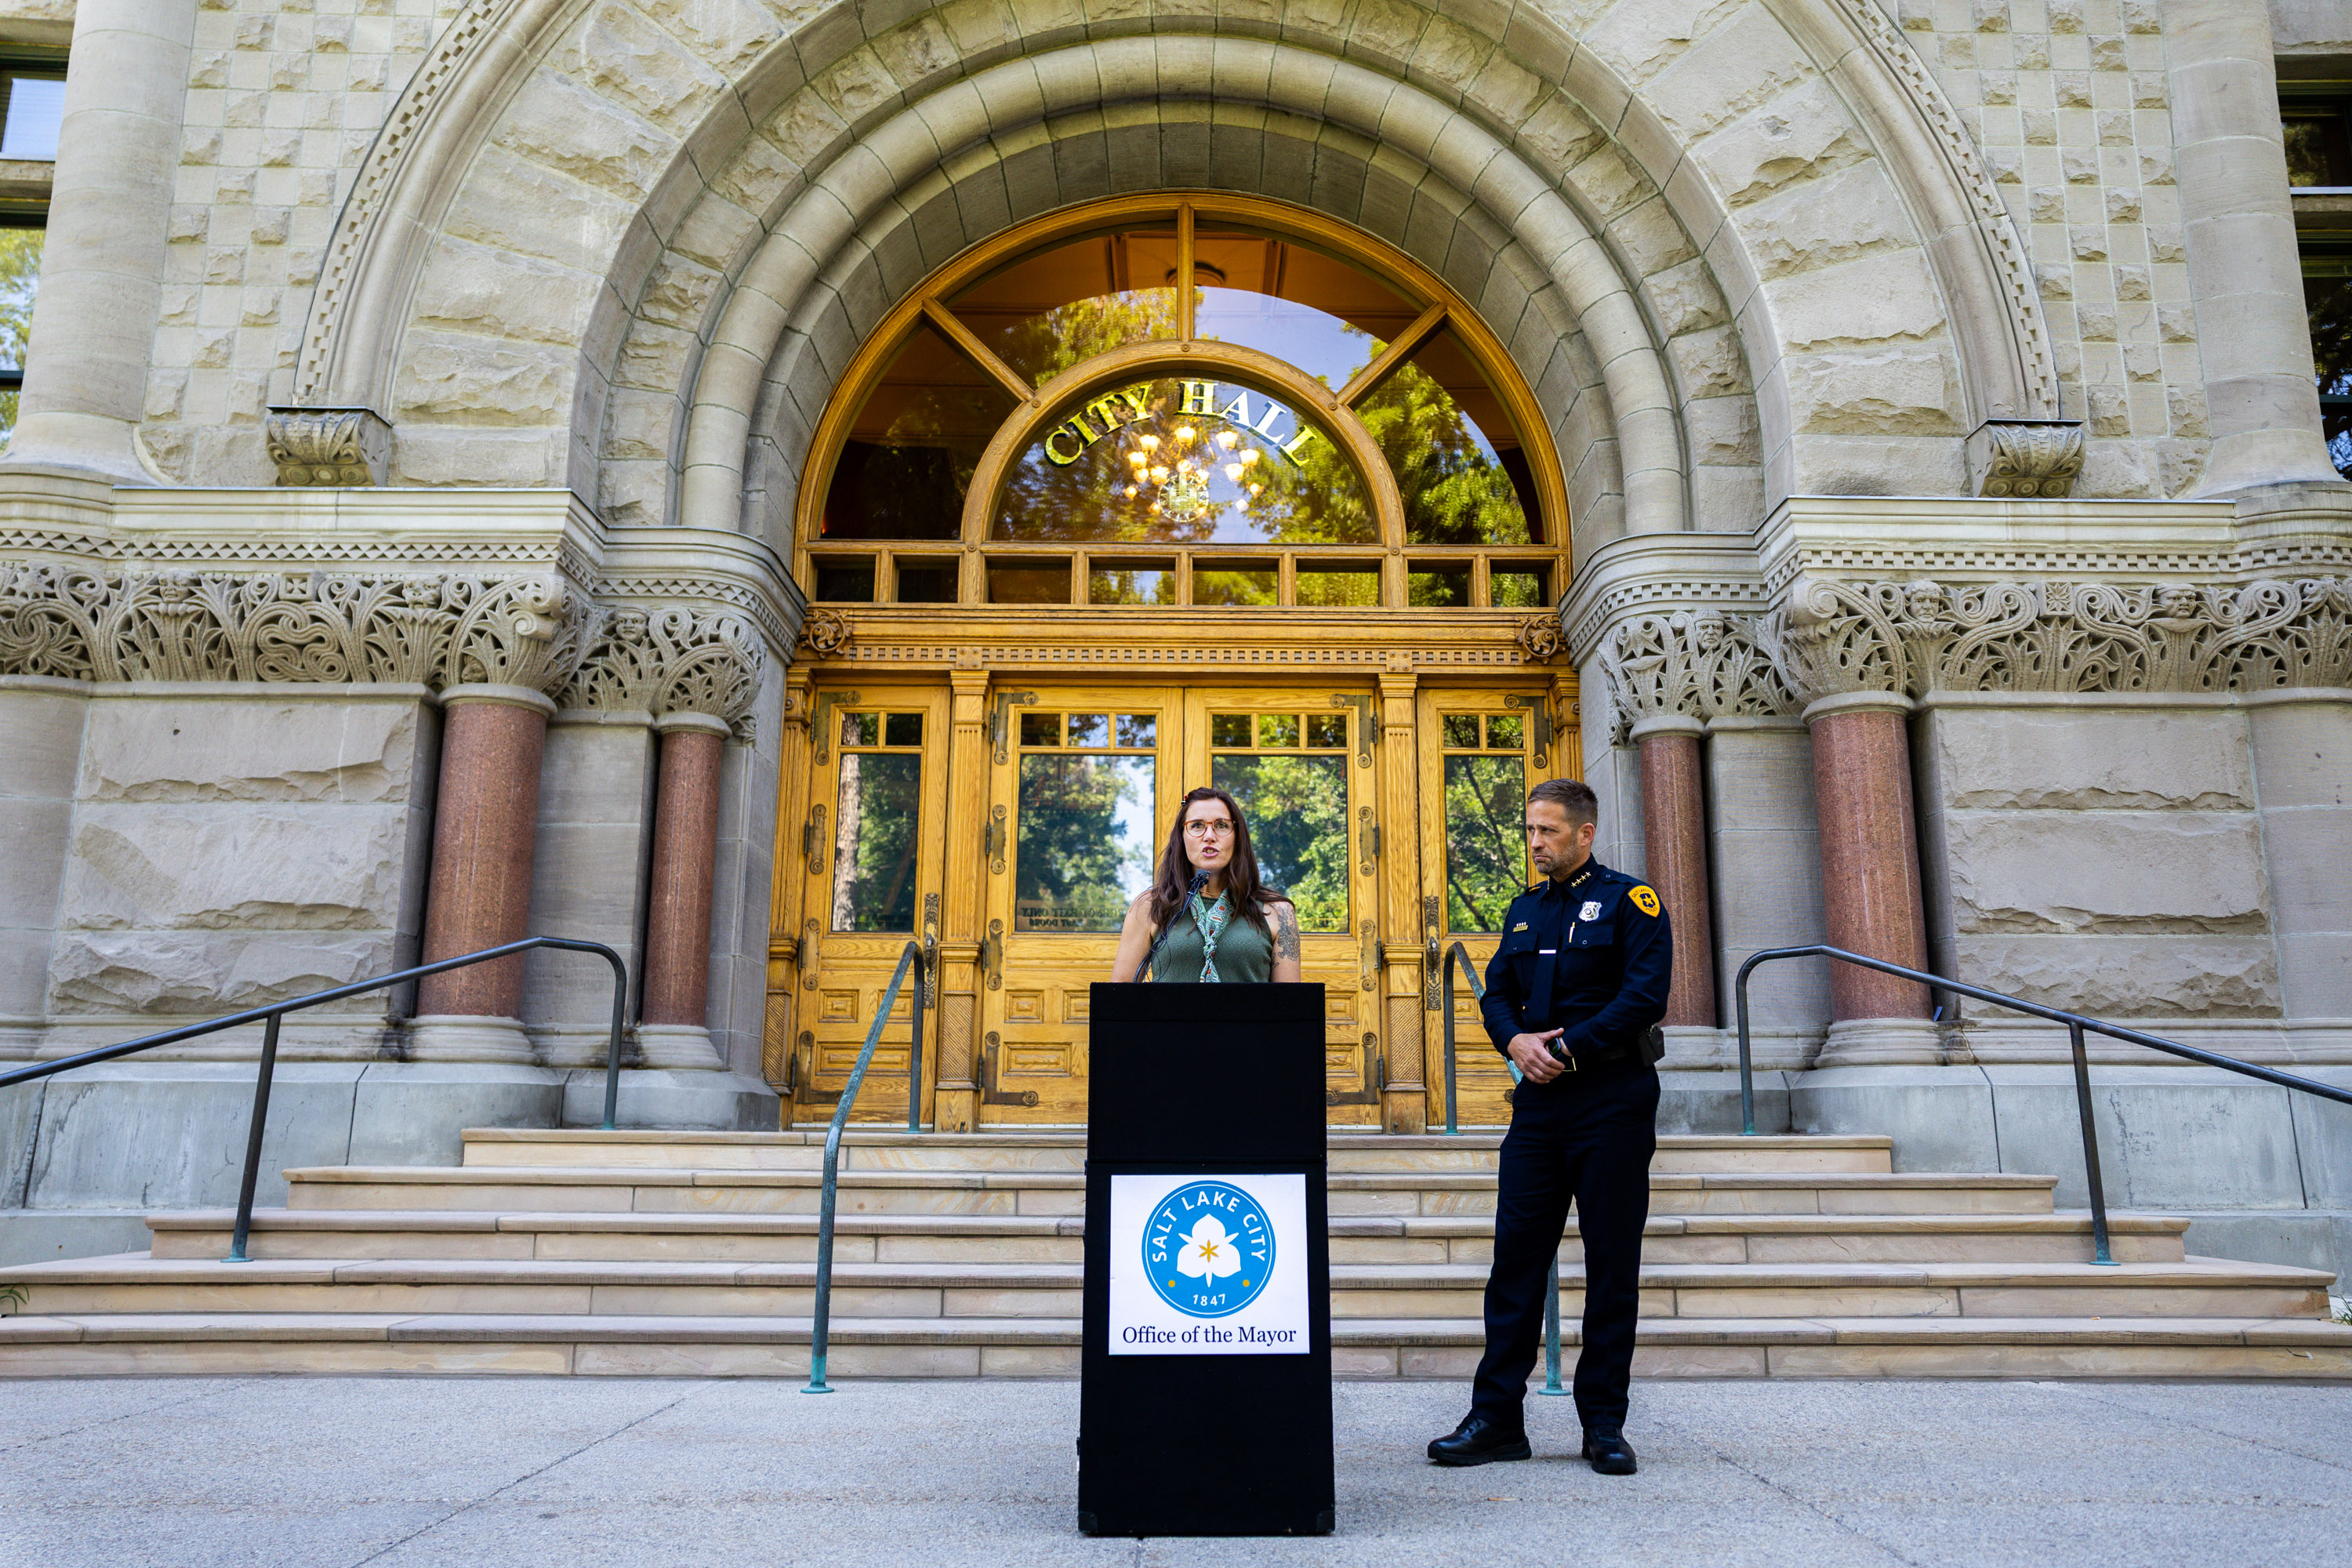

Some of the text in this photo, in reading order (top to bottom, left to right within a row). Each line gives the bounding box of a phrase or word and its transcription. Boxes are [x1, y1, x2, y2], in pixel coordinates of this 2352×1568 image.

[1044, 380, 1318, 467] CITY HALL
[1152, 1191, 1266, 1263] SALT LAKE CITY
[1192, 1294, 1226, 1306] 1847
[1123, 1326, 1297, 1347] Office of the Mayor
